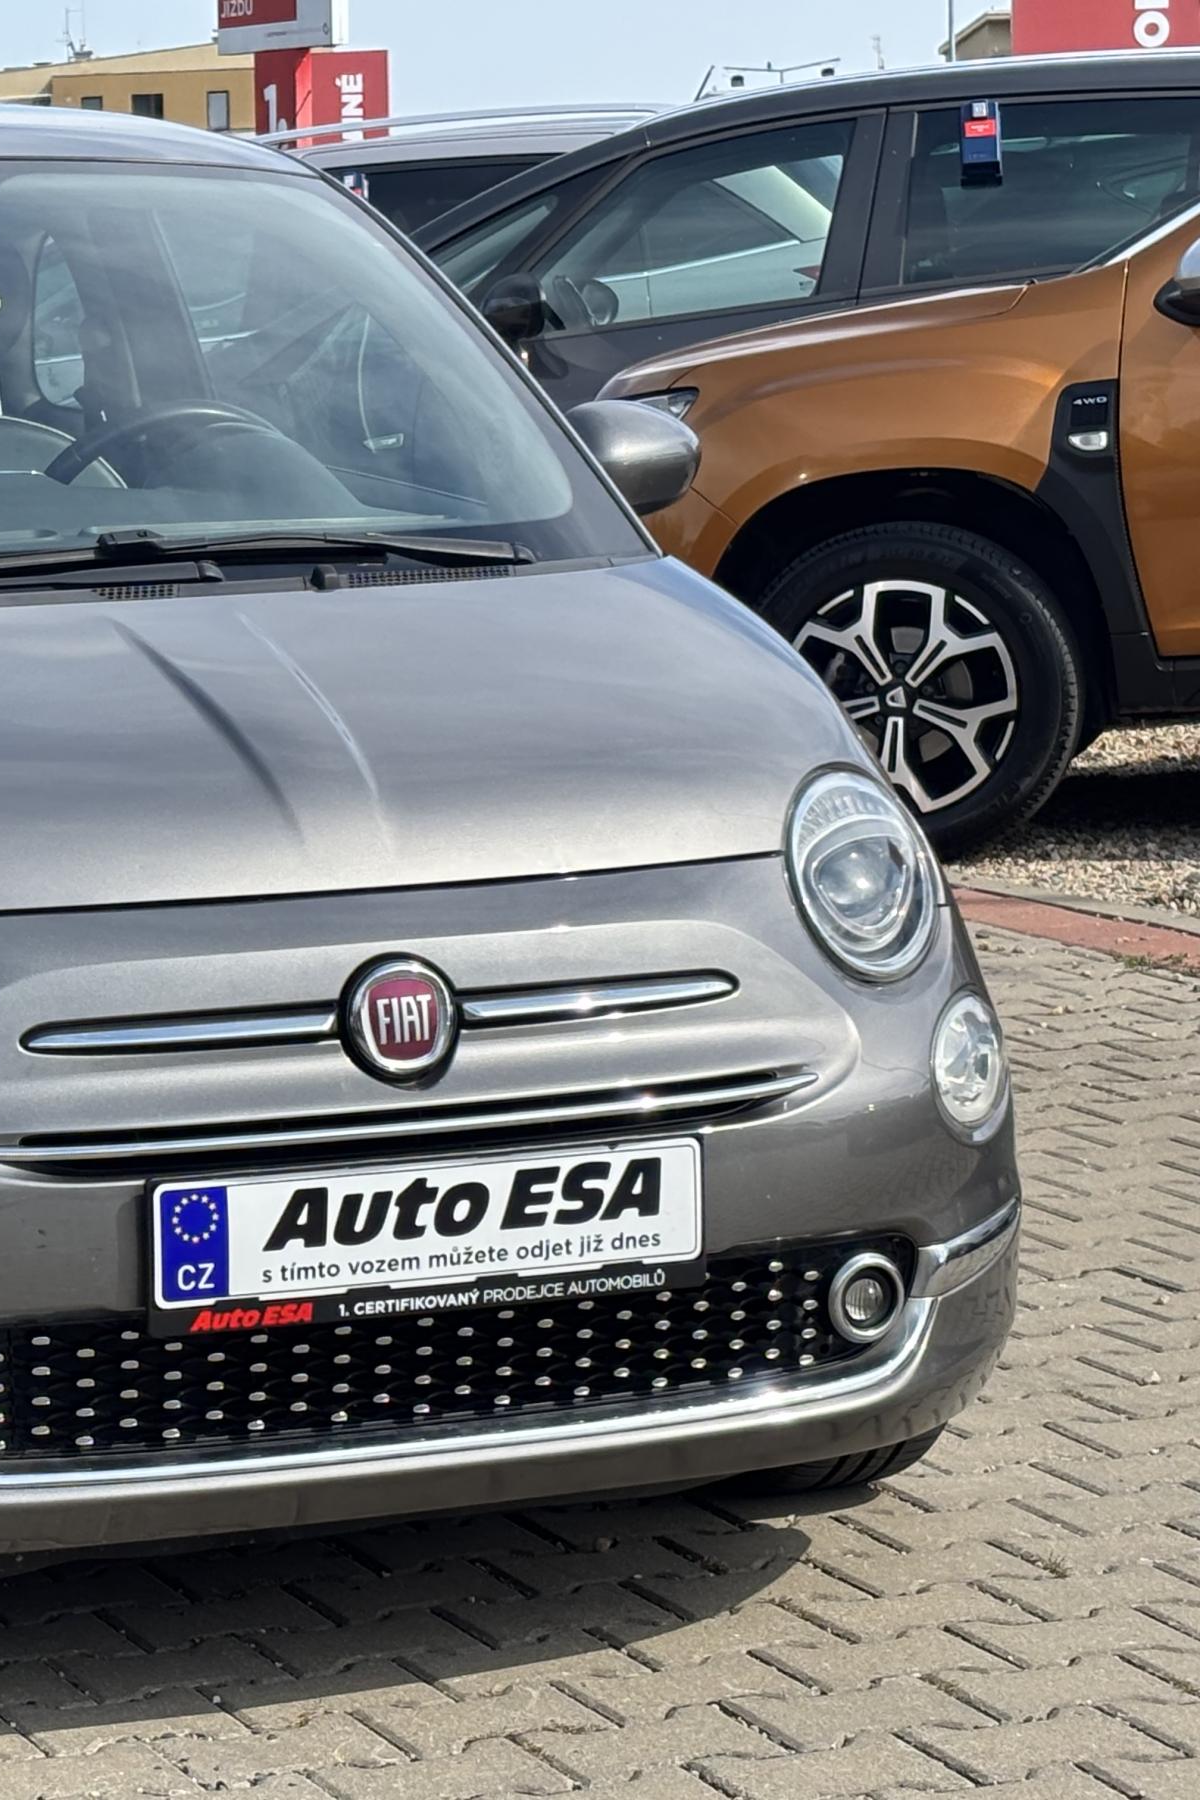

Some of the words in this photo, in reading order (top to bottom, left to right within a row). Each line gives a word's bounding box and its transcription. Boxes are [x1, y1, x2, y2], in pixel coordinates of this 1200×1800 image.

[1073, 396, 1108, 405] 4WD
[376, 994, 432, 1045] FIAT
[262, 1177, 490, 1252] Auto
[500, 1157, 662, 1230] ESA
[177, 1263, 215, 1291] CZ
[262, 1269, 273, 1283] s
[280, 1261, 341, 1281] tímto
[348, 1256, 420, 1275] vozem
[428, 1246, 509, 1268] můžete
[516, 1237, 573, 1260] odjet
[578, 1235, 603, 1257] již
[611, 1231, 661, 1250] dnes
[190, 1309, 259, 1332] Auto
[262, 1302, 314, 1326] ESA
[338, 1304, 350, 1317] 1.
[353, 1289, 480, 1316] CERTIFIKOVANÝ
[483, 1281, 564, 1304] PRODEJCE
[566, 1268, 666, 1296] AUTOMOBILŮ
